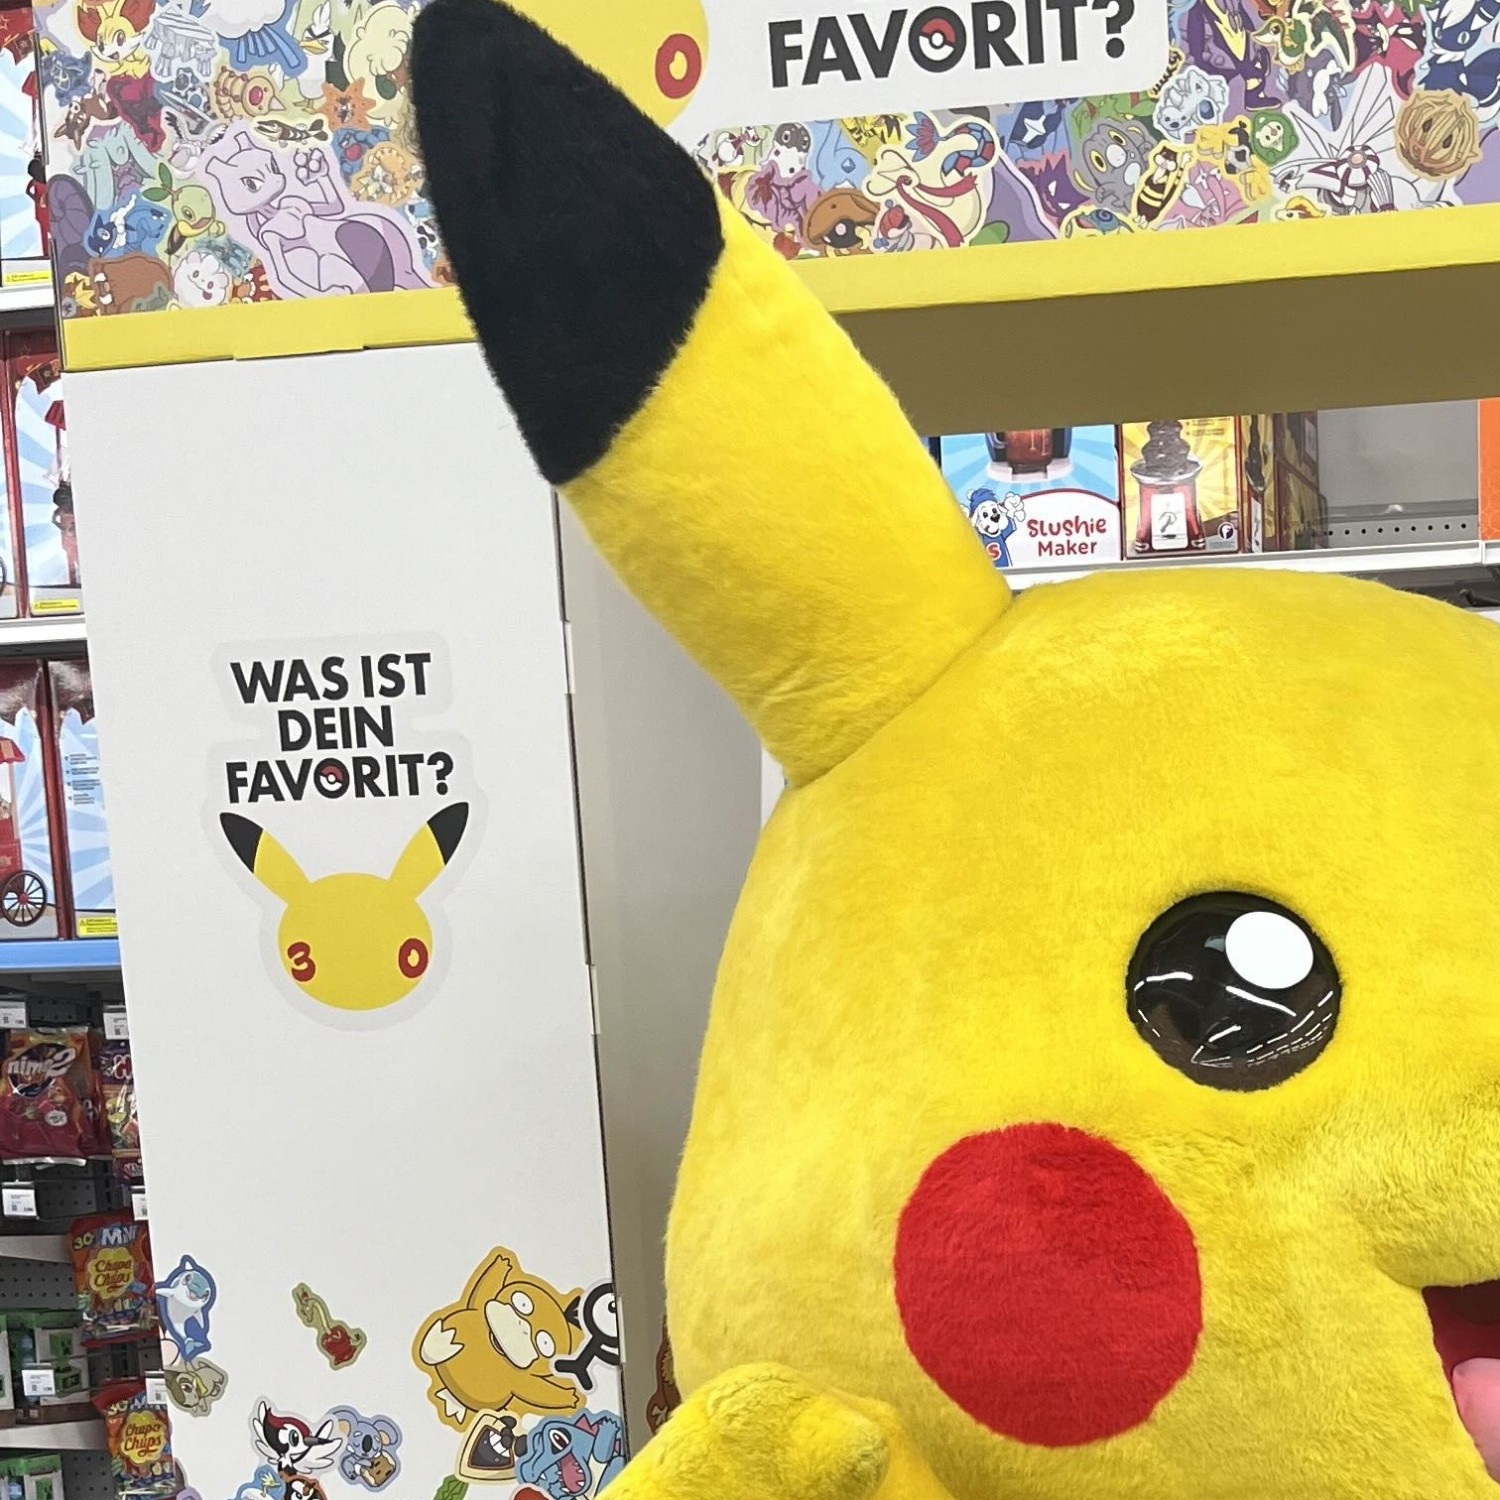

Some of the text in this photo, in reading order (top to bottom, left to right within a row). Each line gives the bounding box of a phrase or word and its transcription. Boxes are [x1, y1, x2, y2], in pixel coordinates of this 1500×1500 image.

[768, 0, 1135, 88] FAVORIT?
[1027, 515, 1107, 538] Slushie
[1038, 539, 1098, 557] Maker
[230, 652, 431, 704] WAS IST
[278, 705, 394, 752] DEIN
[226, 751, 454, 804] FAVORIT?
[124, 1436, 162, 1459] Chups
